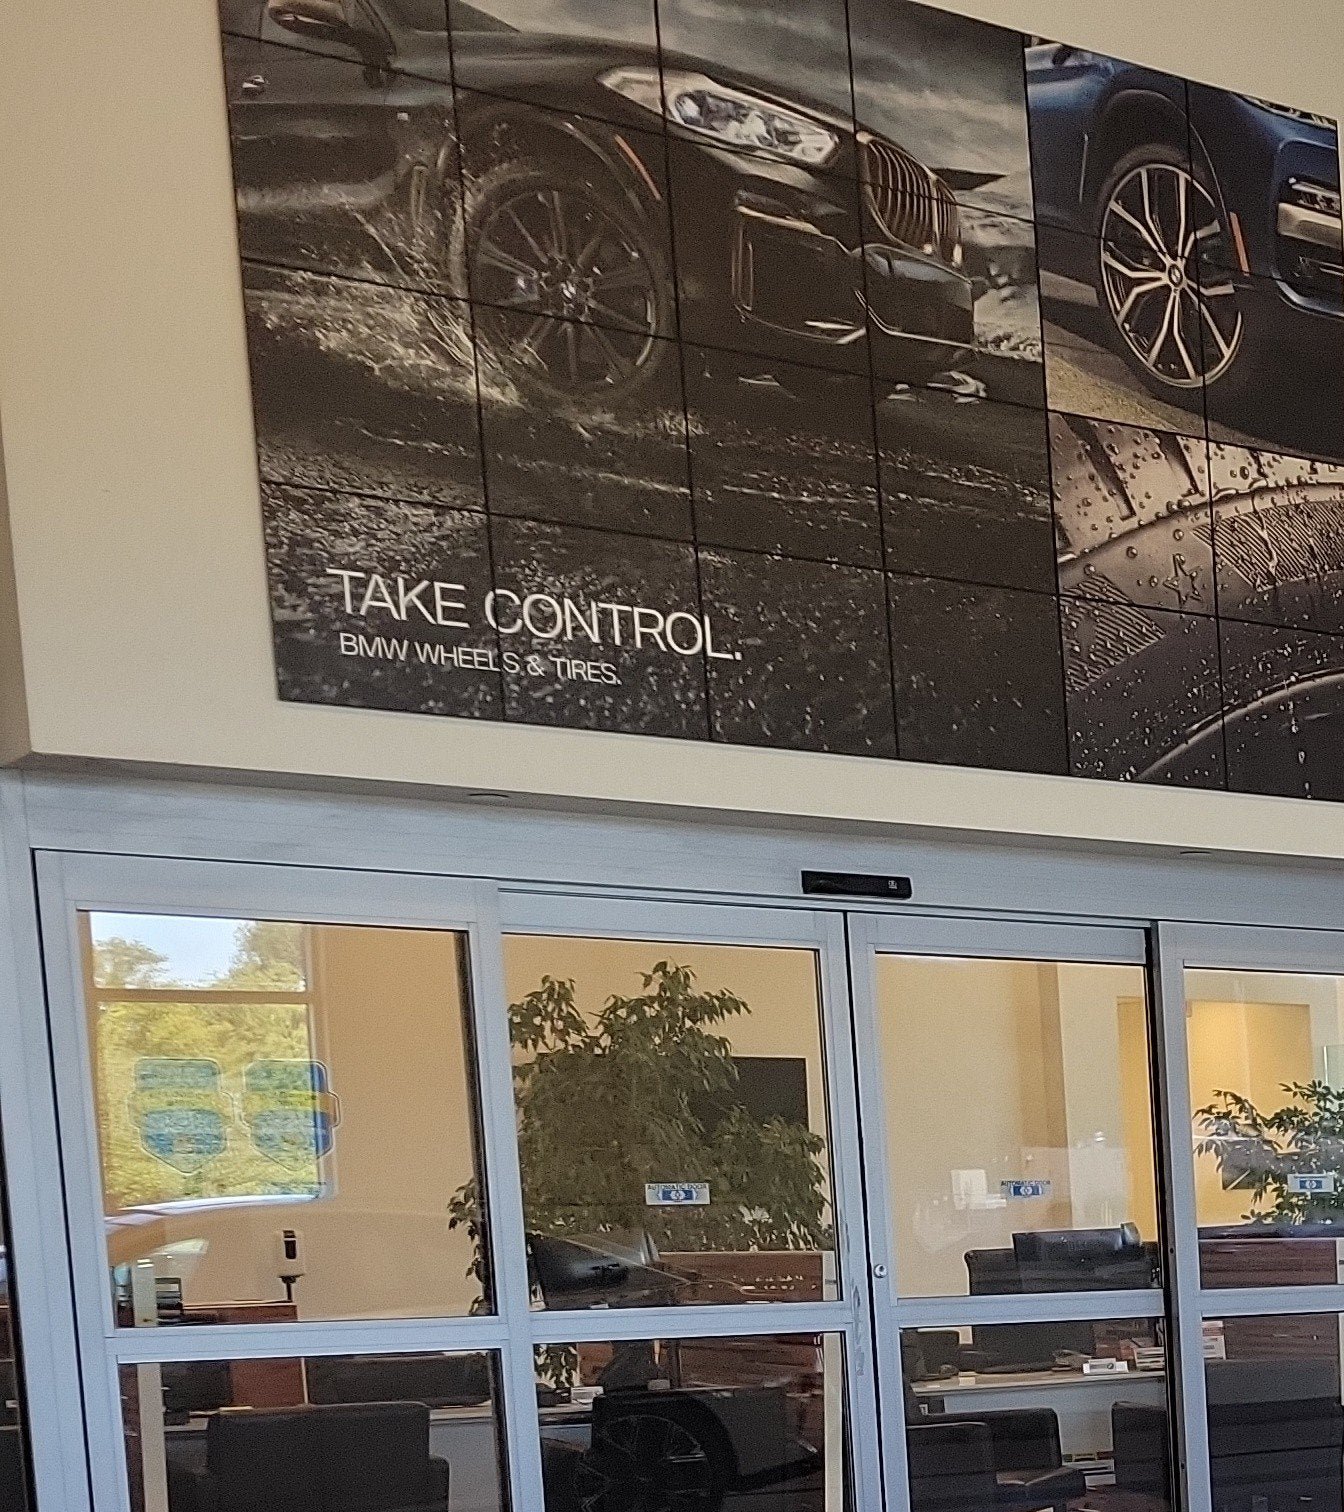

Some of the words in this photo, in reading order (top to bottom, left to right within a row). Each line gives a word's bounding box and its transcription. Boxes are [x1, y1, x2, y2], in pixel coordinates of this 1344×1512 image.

[325, 567, 471, 629] TAKE
[484, 588, 743, 661] CONTROL.
[339, 631, 409, 662] BMW
[414, 640, 521, 674] WHEELS
[526, 654, 546, 677] &
[551, 656, 623, 686] TIRES.
